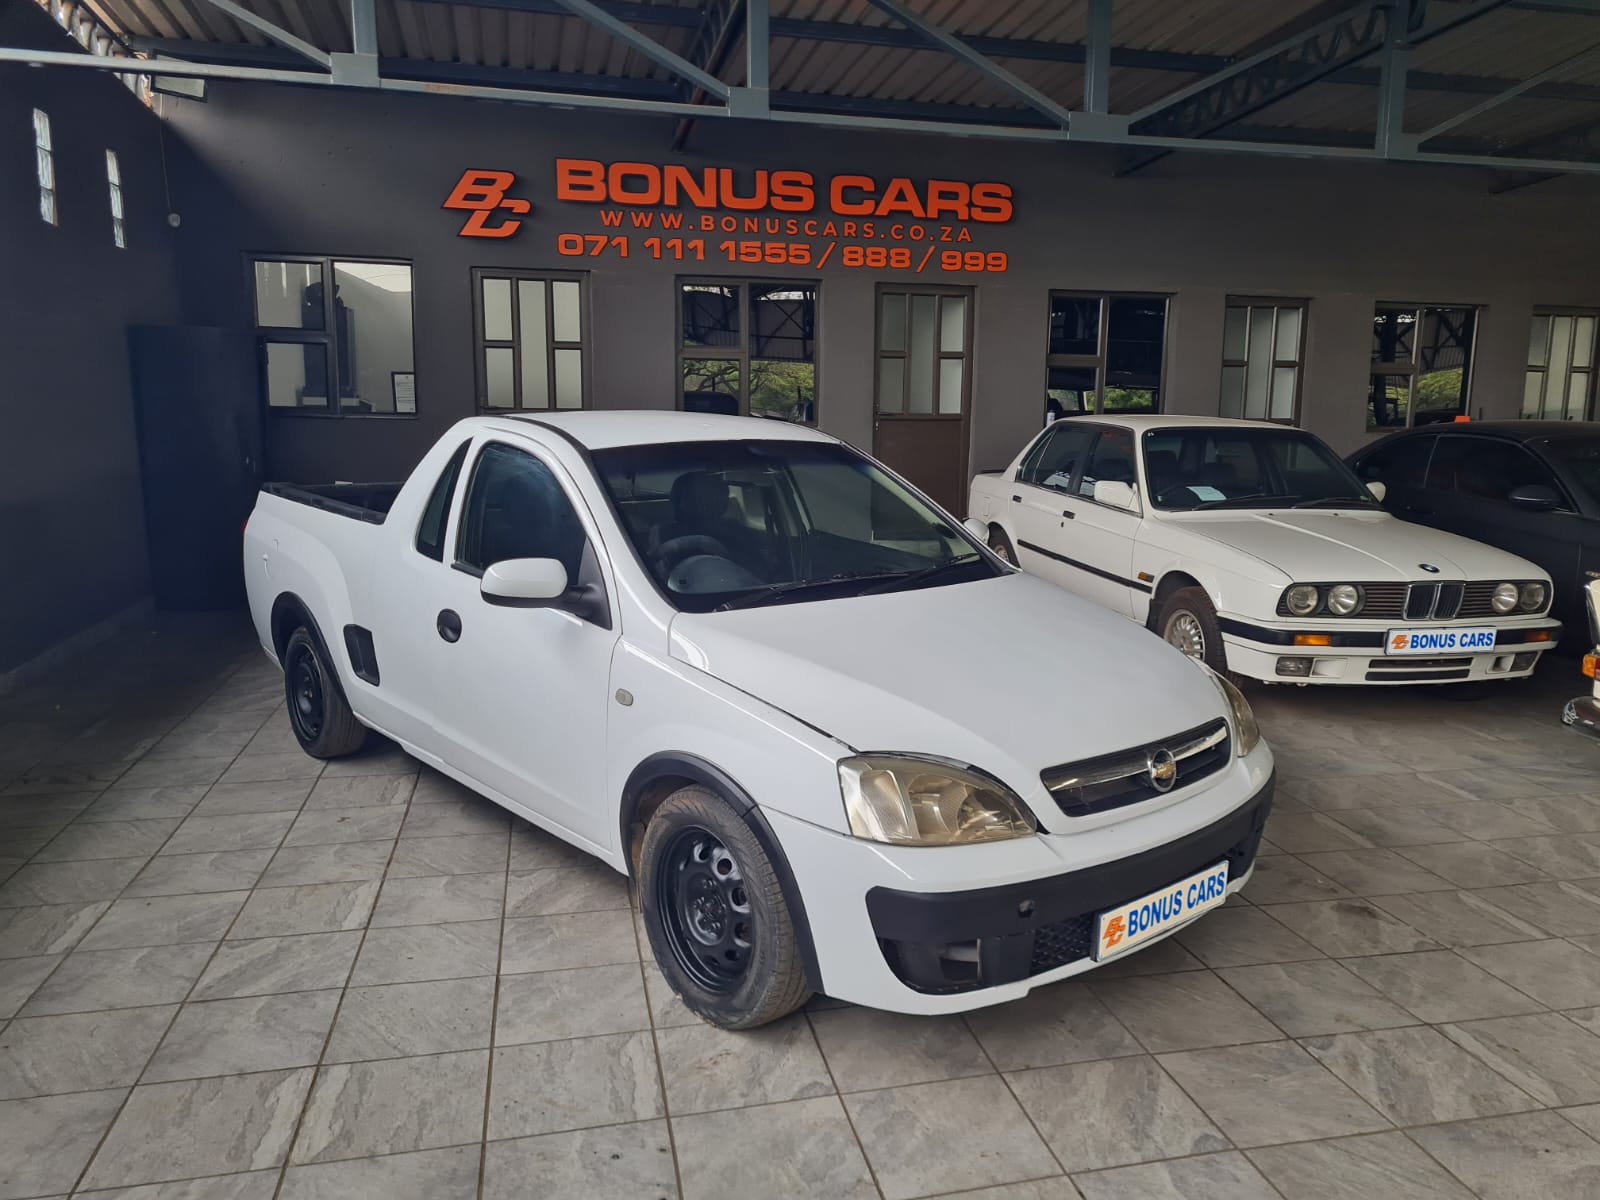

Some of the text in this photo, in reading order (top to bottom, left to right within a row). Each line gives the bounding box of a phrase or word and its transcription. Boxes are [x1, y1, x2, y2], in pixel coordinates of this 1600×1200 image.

[555, 158, 1013, 223] BONUS CARS
[599, 209, 972, 243] WWW.BONUSCARS.CO.ZA
[557, 233, 628, 258] 071
[643, 237, 705, 261] 111
[719, 239, 812, 266] 1555
[842, 245, 912, 269] 888
[940, 250, 1009, 273] 999
[1410, 634, 1456, 649] BONUS
[1459, 632, 1494, 648] CARS
[1128, 890, 1183, 937] BONUS
[1187, 871, 1225, 909] CARS
